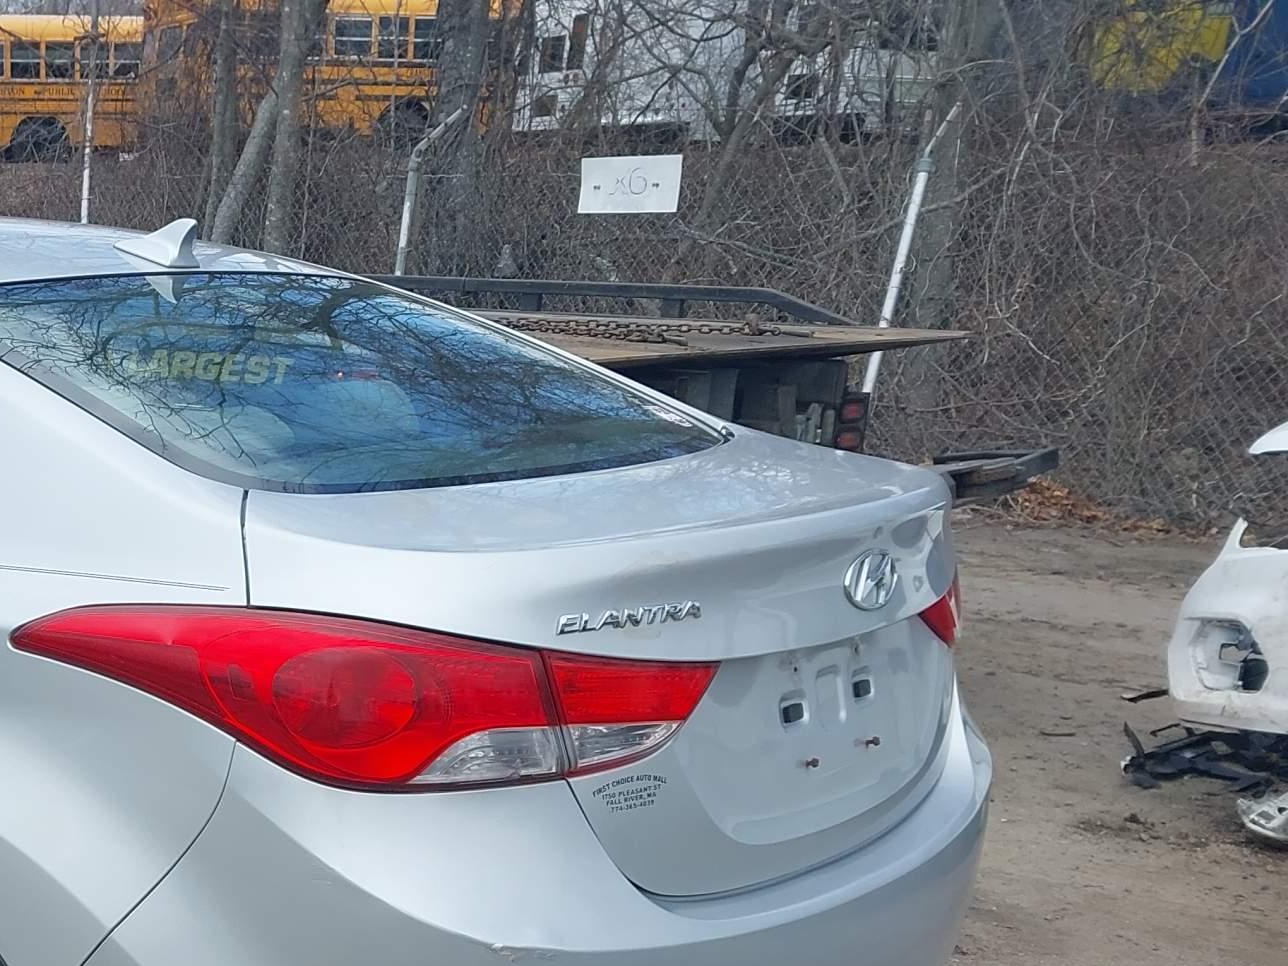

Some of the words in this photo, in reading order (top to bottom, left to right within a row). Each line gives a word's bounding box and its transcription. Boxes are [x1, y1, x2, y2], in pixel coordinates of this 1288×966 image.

[556, 600, 702, 635] ELANTRA
[592, 783, 610, 797] FIRST
[612, 776, 634, 787] CHOICE
[653, 775, 667, 784] MALL
[618, 785, 651, 797] PLEASANT
